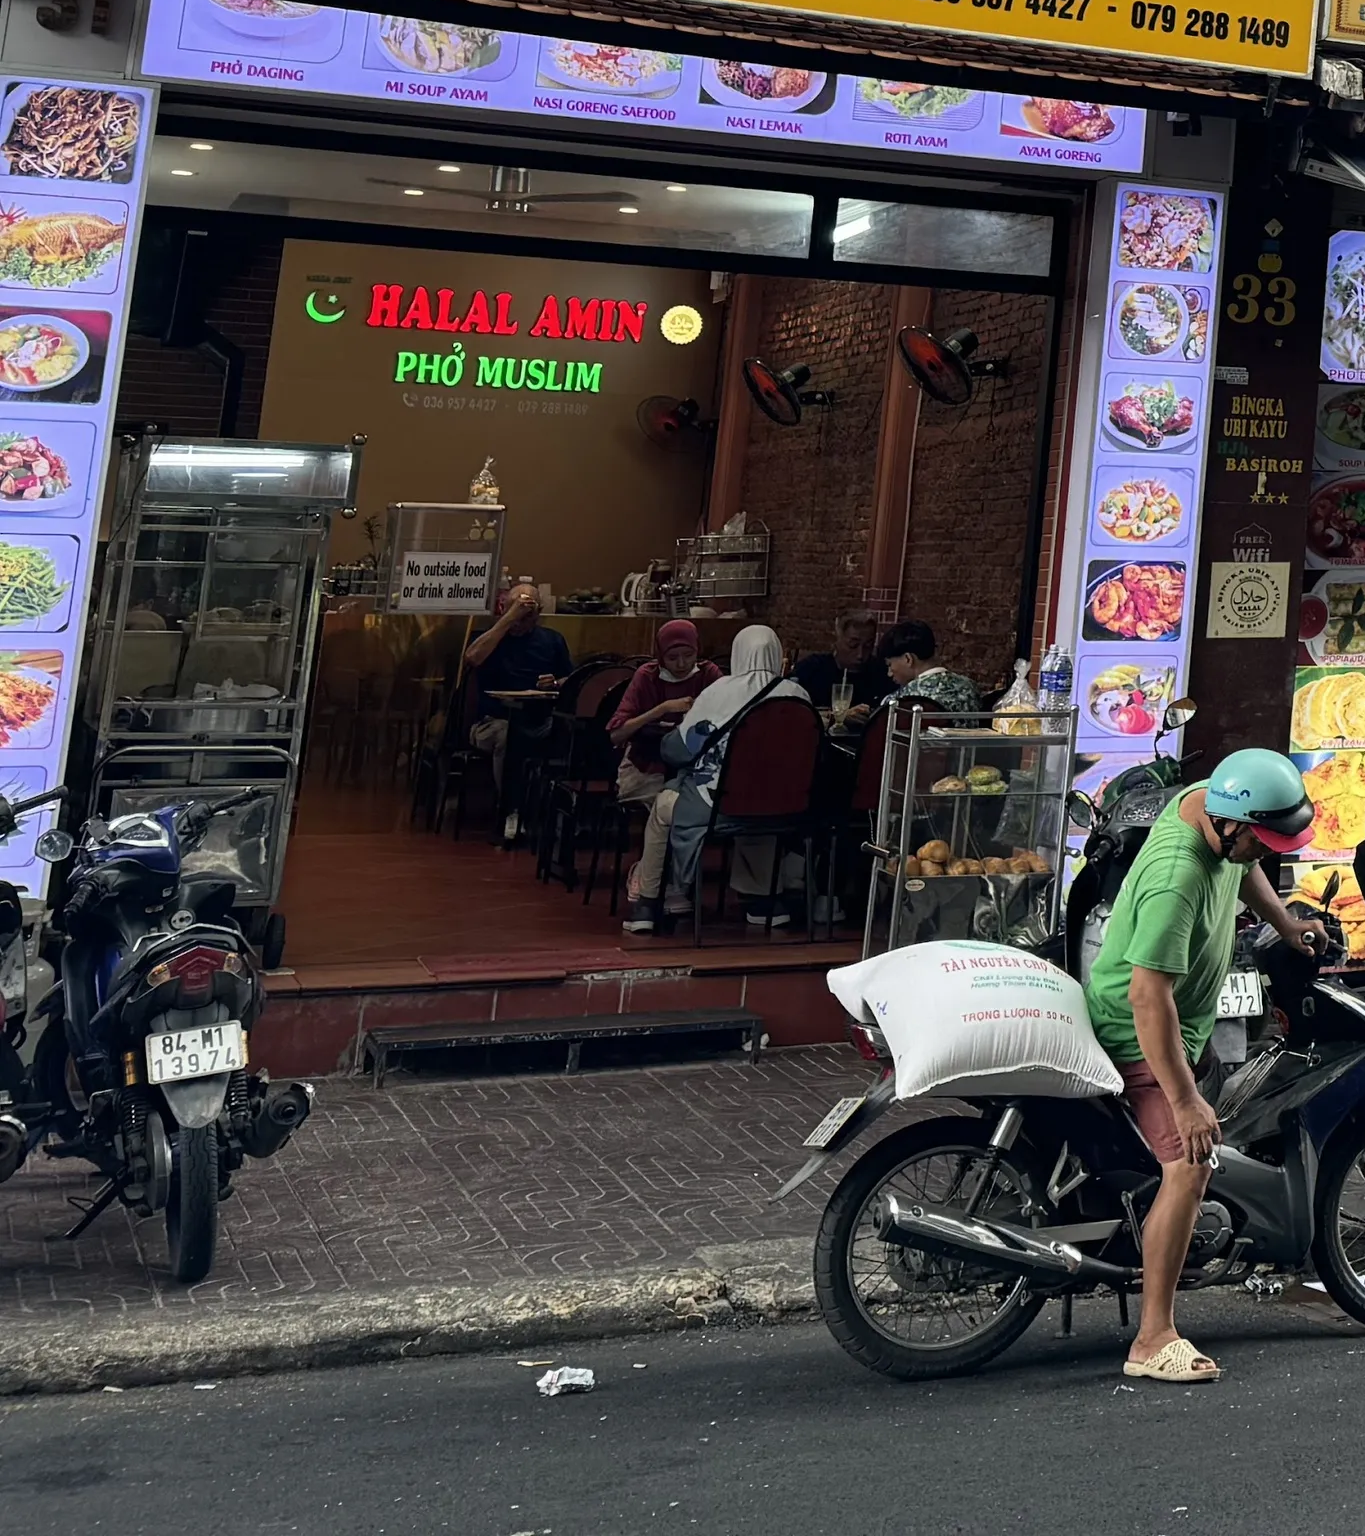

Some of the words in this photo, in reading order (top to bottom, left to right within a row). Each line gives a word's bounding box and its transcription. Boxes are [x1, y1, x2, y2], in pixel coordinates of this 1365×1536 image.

[1131, 1, 1176, 33] 079
[1184, 8, 1229, 40] 288
[1238, 15, 1290, 48] 1489
[210, 59, 243, 75] PHỞ
[247, 64, 304, 81] DAGING
[385, 80, 403, 93] MI
[407, 83, 447, 98] SOUP
[449, 87, 488, 102] AYAM
[533, 96, 563, 112] NASI
[566, 99, 618, 118] GORENG
[621, 105, 676, 123] SAEFOOD
[726, 116, 756, 131] NASI
[760, 118, 803, 135] LEMAK
[885, 131, 913, 145] ROTI
[915, 134, 948, 150] AYAM
[1020, 144, 1052, 160] AYAM
[1054, 148, 1102, 164] GORENG
[1226, 273, 1298, 326] 33
[366, 283, 519, 336] HALAL
[530, 295, 648, 343] AMIN
[394, 342, 466, 387] PHỞ
[475, 356, 603, 393] MUSLIM
[1328, 368, 1353, 381] PHO
[1223, 417, 1247, 437] UBI
[1249, 418, 1288, 439] KAYU
[1233, 546, 1270, 562] Wifi
[406, 560, 421, 577] No
[424, 561, 460, 578] outside
[464, 562, 487, 578] food
[403, 585, 414, 598] or
[418, 583, 444, 600] drink
[447, 583, 485, 600] allowed
[941, 958, 966, 973] TÀI
[971, 955, 1021, 968] NGUYÊN
[1025, 958, 1048, 973] CHỢ
[161, 1026, 229, 1057] 84-M1
[153, 1049, 238, 1081] 139.74
